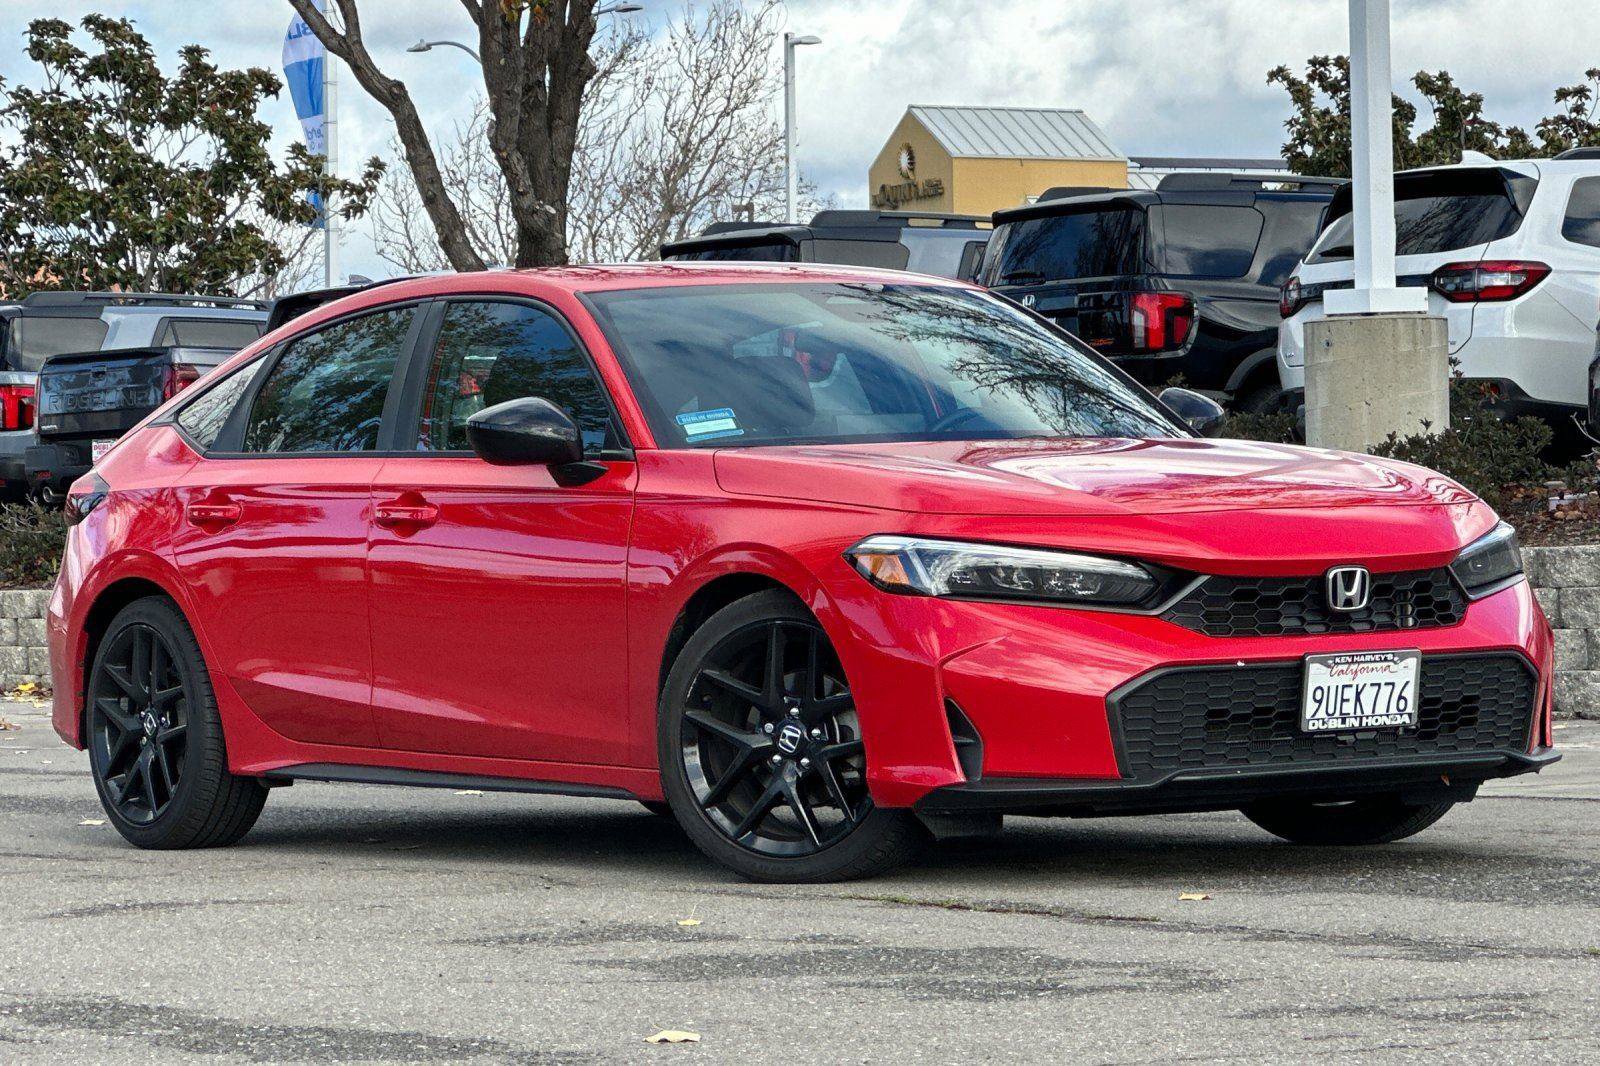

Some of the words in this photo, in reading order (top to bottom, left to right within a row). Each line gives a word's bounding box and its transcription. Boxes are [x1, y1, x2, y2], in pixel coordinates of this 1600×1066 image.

[1335, 656, 1353, 664] KEN
[1353, 654, 1394, 662] HARVEY'S
[1311, 681, 1410, 718] 9UEK776
[1361, 714, 1411, 727] HONDA
